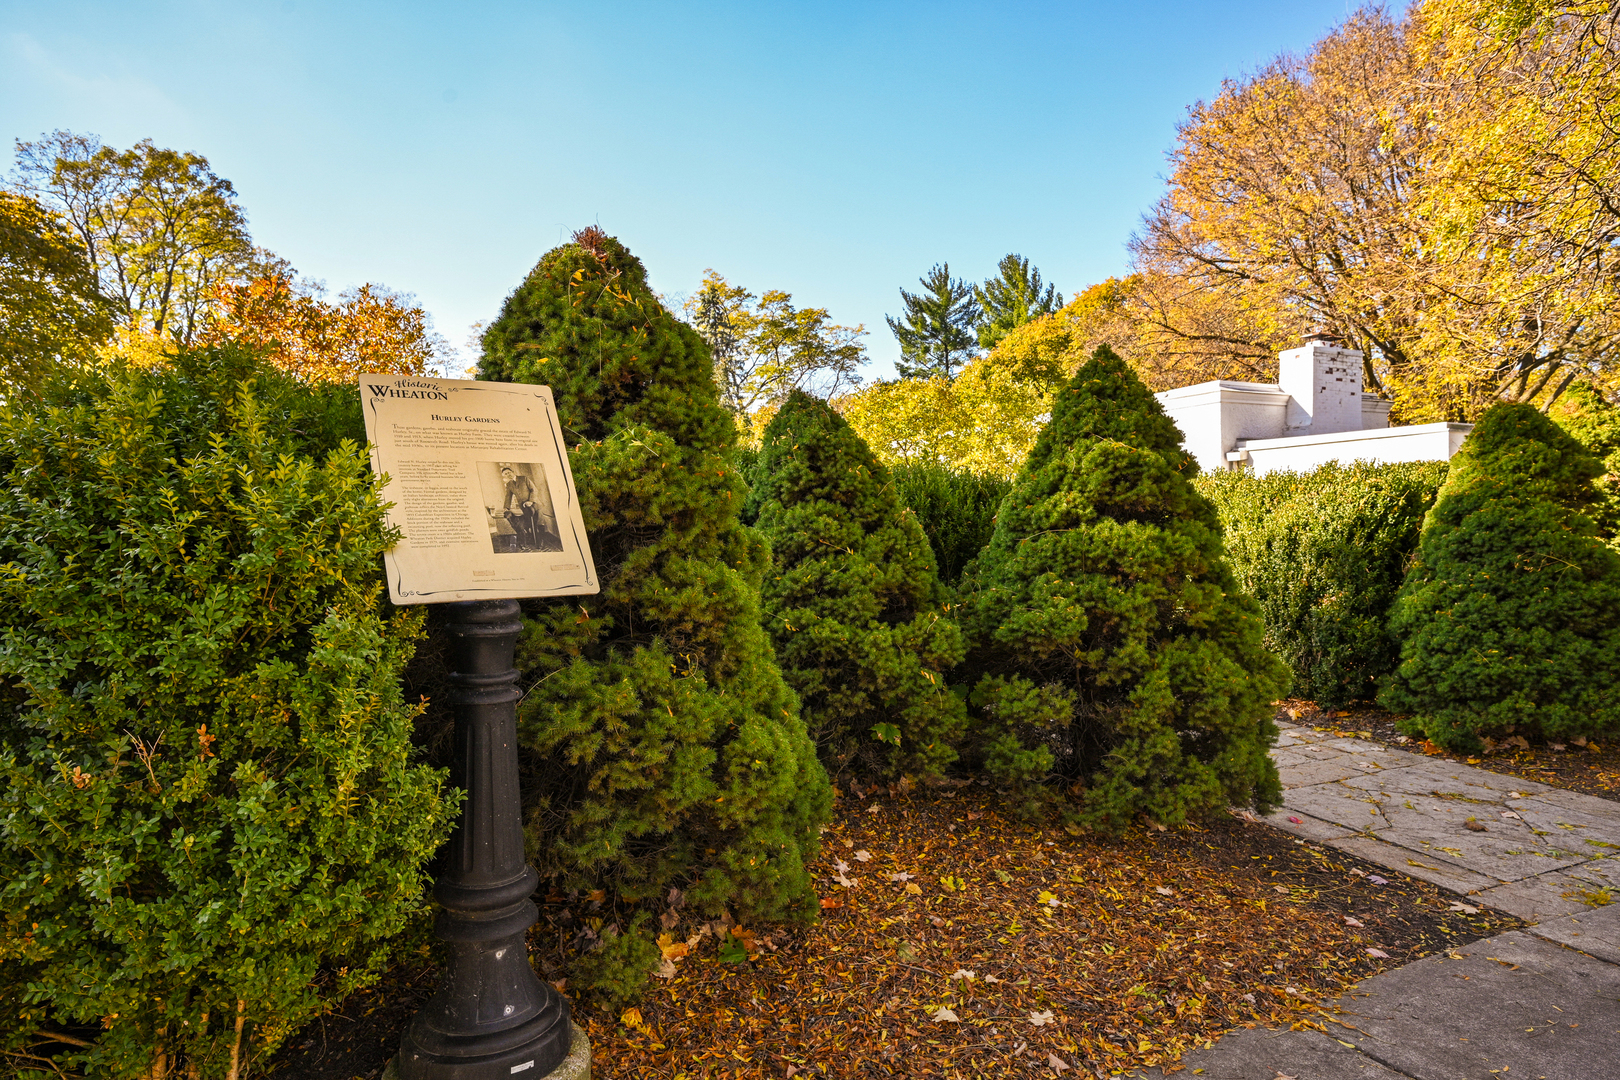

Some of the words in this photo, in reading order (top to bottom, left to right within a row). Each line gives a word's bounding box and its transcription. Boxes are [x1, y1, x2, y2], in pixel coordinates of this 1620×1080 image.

[394, 379, 443, 391] Historic
[367, 384, 448, 401] WHEATON
[431, 414, 462, 422] HURLEY
[465, 415, 500, 424] GARDENS
